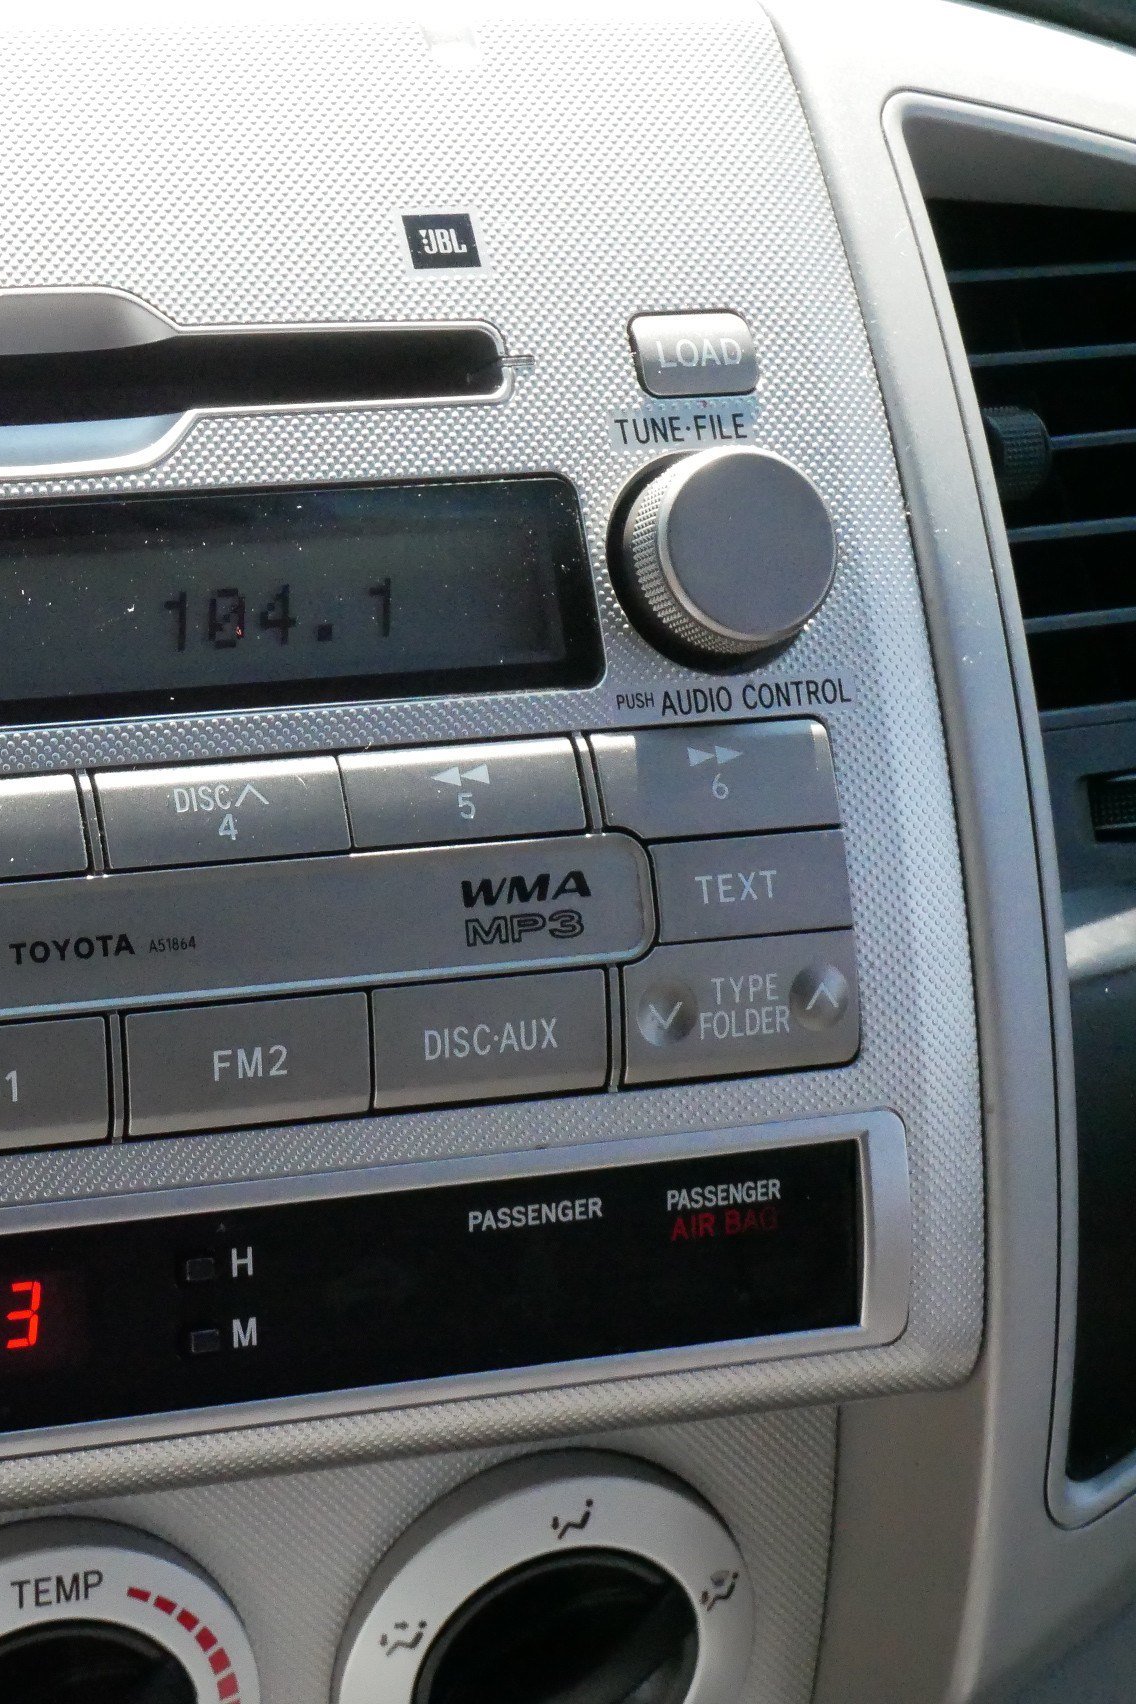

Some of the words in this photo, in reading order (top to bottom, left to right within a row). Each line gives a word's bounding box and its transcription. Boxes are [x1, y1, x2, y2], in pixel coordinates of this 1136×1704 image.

[420, 229, 467, 254] JBL
[657, 338, 742, 368] LOAD
[165, 577, 393, 651] 104.1
[616, 692, 655, 710] PUSH
[661, 686, 732, 716] AUDIO
[742, 678, 852, 710] CONTROL
[173, 785, 232, 814] DISC
[712, 773, 729, 799] 6
[457, 792, 476, 820] 5
[218, 814, 238, 841] 4
[461, 870, 591, 909] WMA
[695, 870, 777, 904] TEXT
[465, 909, 585, 947] MP3
[9, 934, 135, 965] TOYOTA
[149, 936, 196, 953] A51864
[710, 973, 779, 1003] TYPE
[699, 1006, 791, 1040] FOLDER
[213, 1044, 289, 1082] FM2
[666, 1179, 781, 1211] PASSENGER
[468, 1197, 603, 1233] PASSENGER
[671, 1213, 716, 1242] AIR
[725, 1206, 779, 1236] BAG
[231, 1246, 254, 1278] H
[232, 1317, 258, 1349] M
[10, 1570, 104, 1609] TEMP
